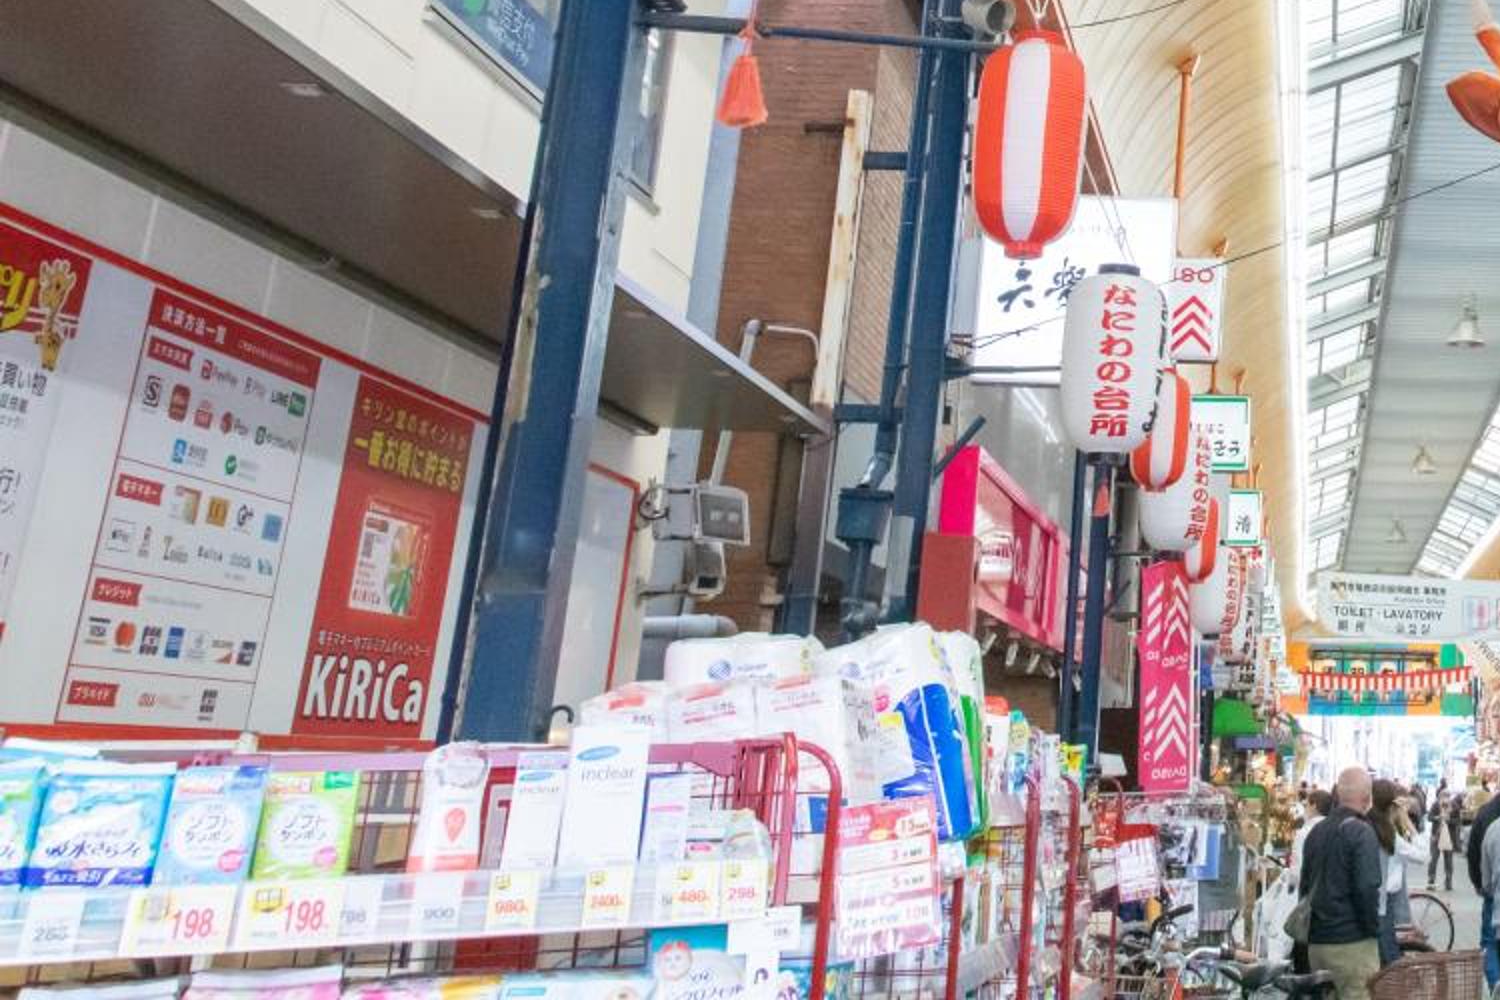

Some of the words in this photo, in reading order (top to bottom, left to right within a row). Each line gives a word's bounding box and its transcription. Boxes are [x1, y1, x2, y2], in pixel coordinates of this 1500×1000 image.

[1089, 284, 1137, 438] なにわの台所
[1333, 605, 1374, 618] TOILET
[1383, 609, 1443, 622] LAVATORY
[302, 653, 424, 724] KiRiCa
[580, 764, 635, 781] inclear
[171, 908, 215, 939] 198
[284, 899, 324, 932] 198
